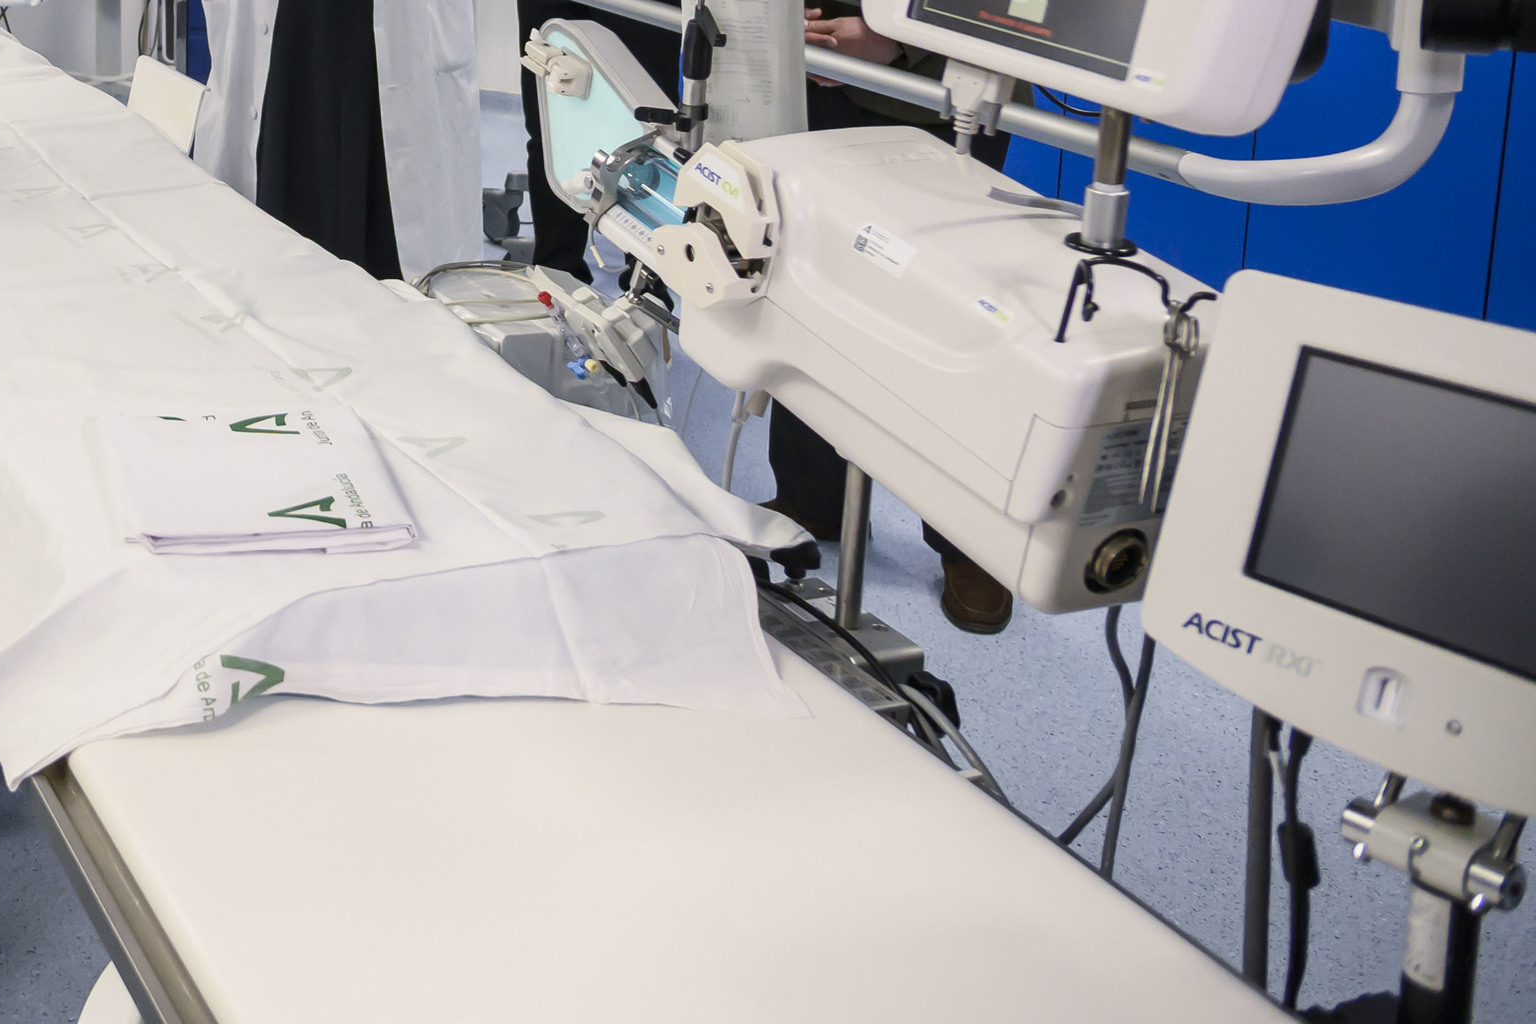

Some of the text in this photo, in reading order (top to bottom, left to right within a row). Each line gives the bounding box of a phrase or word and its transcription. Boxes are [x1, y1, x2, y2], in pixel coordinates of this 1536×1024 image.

[694, 162, 722, 185] ACIST
[1182, 612, 1263, 654] ACIST
[195, 671, 212, 692] de
